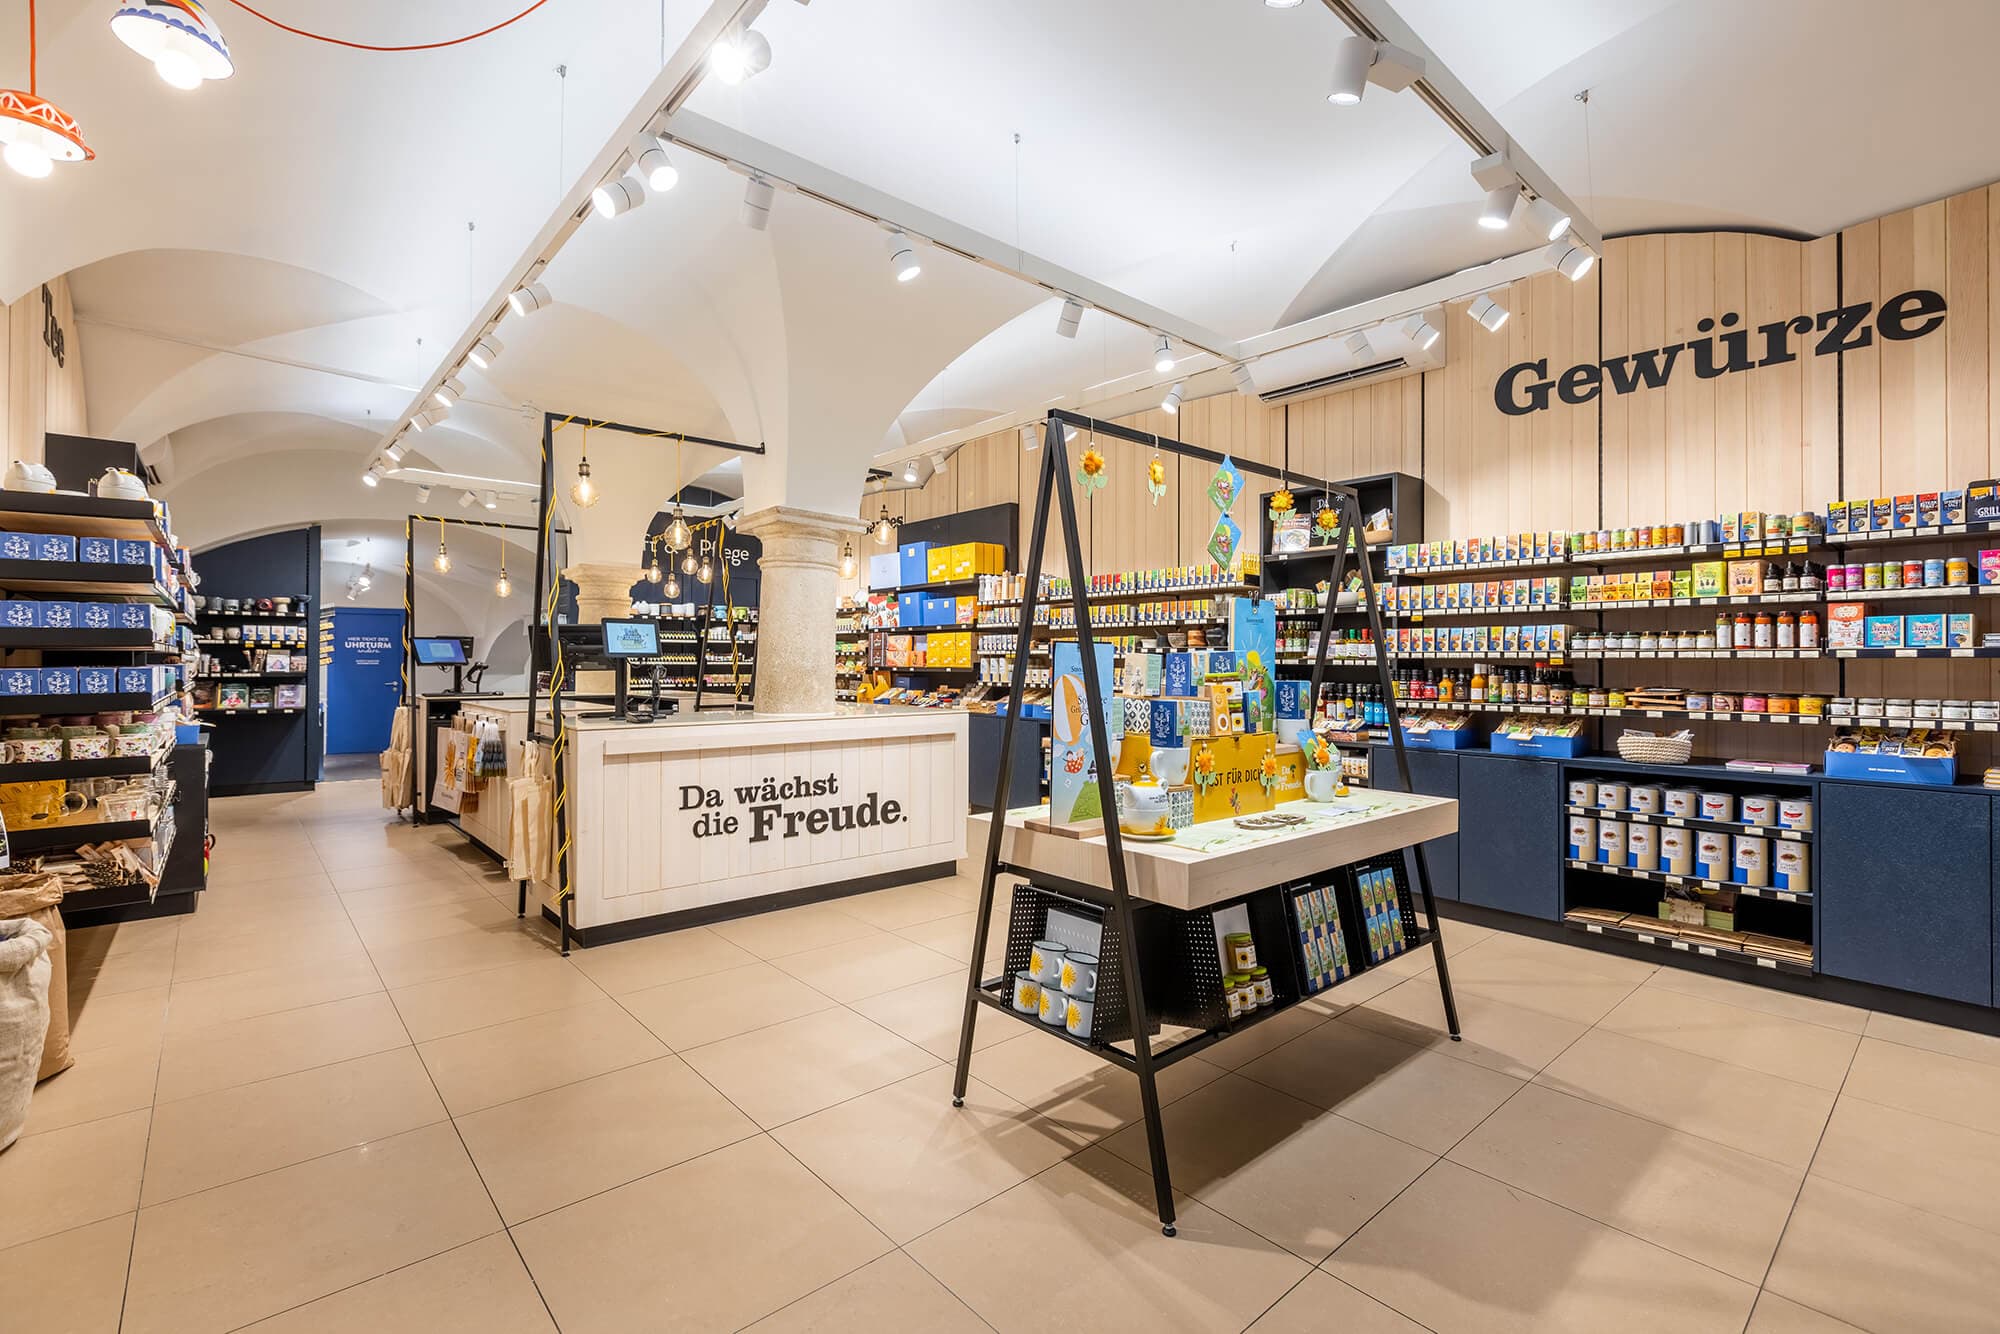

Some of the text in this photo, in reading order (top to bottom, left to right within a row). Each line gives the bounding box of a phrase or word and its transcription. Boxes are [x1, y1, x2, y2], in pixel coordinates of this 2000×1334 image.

[42, 283, 65, 369] Tee
[1494, 289, 1948, 416] Gewürze
[700, 539, 749, 566] Pfege
[679, 772, 839, 810] Da wächst
[1226, 768, 1242, 784] FÜR
[692, 792, 908, 843] die Freude.
